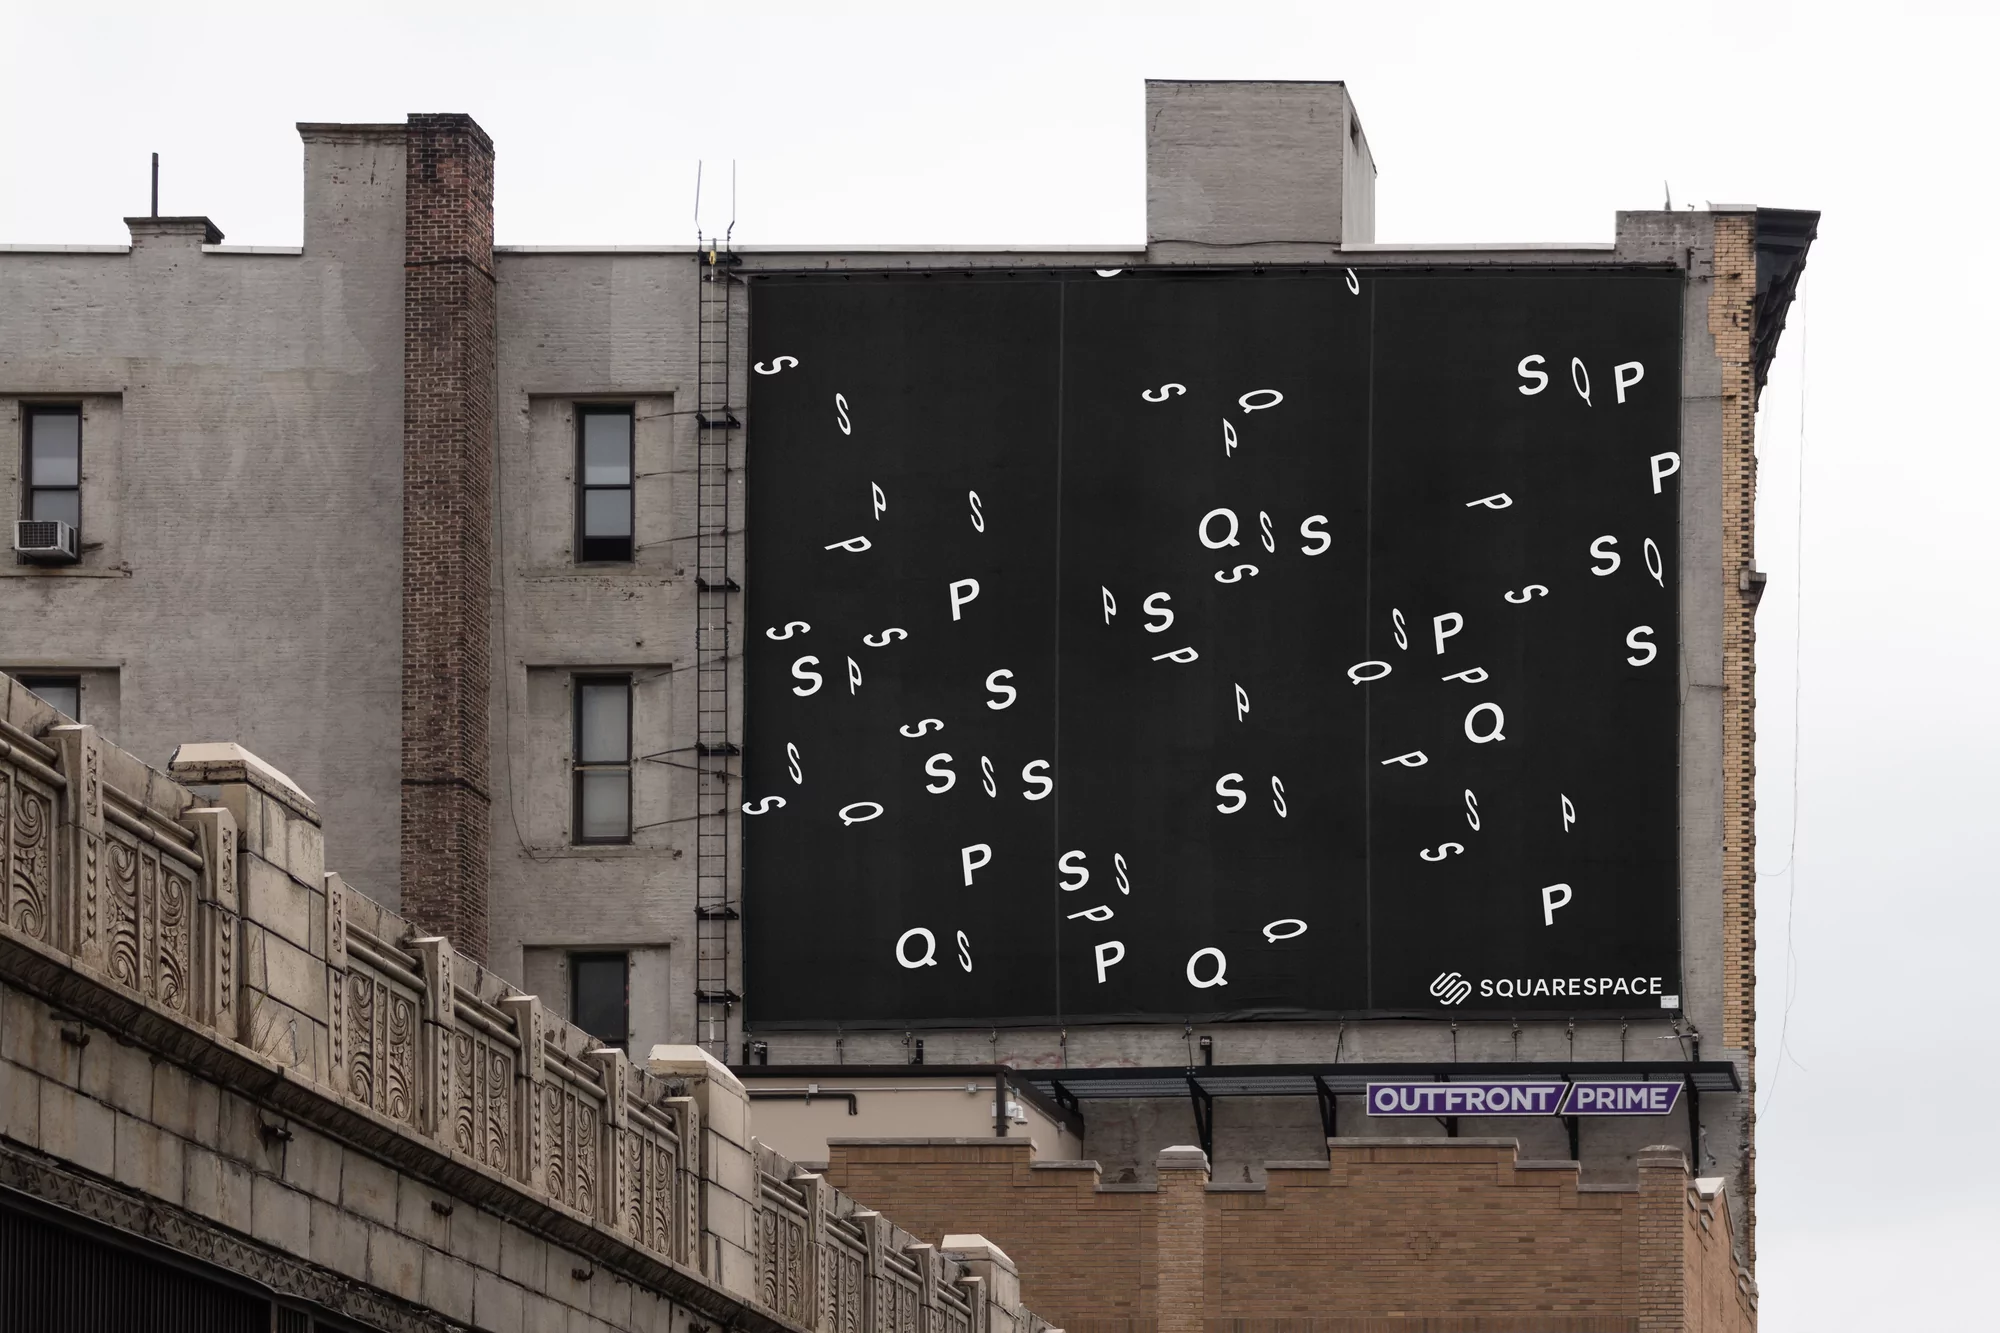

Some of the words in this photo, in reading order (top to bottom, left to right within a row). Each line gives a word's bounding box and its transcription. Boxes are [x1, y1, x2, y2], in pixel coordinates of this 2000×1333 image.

[754, 356, 798, 374] S
[1518, 355, 1548, 395] S
[1572, 357, 1591, 406] Q
[1615, 362, 1644, 403] P
[1142, 384, 1186, 402] S
[1239, 390, 1283, 413] Q
[836, 393, 851, 435] S
[1223, 418, 1237, 457] P
[1651, 452, 1680, 494] P
[872, 482, 886, 520] P
[969, 491, 984, 532] S
[1466, 493, 1512, 509] P
[825, 536, 871, 552] P
[1199, 508, 1240, 549] Q
[1260, 511, 1274, 553] S
[1301, 515, 1331, 555] S
[1215, 565, 1259, 583] S
[1590, 536, 1620, 576] S
[1644, 538, 1664, 587] Q
[950, 579, 979, 621] P
[1102, 586, 1116, 624] P
[1143, 592, 1174, 632] S
[1505, 585, 1548, 603] S
[766, 622, 810, 640] S
[863, 628, 907, 646] S
[1393, 608, 1407, 650] S
[1434, 613, 1463, 654] P
[1627, 626, 1656, 666] S
[1152, 647, 1198, 663] P
[1348, 661, 1392, 685] Q
[792, 656, 822, 696] S
[848, 656, 861, 695] P
[986, 669, 1016, 710] S
[1442, 667, 1488, 683] P
[1235, 683, 1249, 722] P
[900, 719, 944, 737] S
[1465, 703, 1505, 743] Q
[787, 743, 802, 784] S
[925, 753, 956, 794] S
[981, 756, 996, 797] S
[1022, 760, 1053, 800] S
[1382, 751, 1428, 767] P
[742, 796, 786, 814] S
[839, 802, 883, 826] Q
[1216, 773, 1246, 813] S
[1272, 776, 1286, 817] S
[1465, 789, 1480, 831] S
[1561, 794, 1575, 832] P
[962, 844, 991, 886] P
[1420, 843, 1464, 861] S
[1059, 850, 1089, 891] S
[1115, 853, 1129, 895] S
[1067, 905, 1114, 921] P
[1542, 884, 1571, 926] P
[896, 928, 937, 968] Q
[957, 930, 972, 972] S
[1263, 919, 1307, 943] Q
[1095, 941, 1124, 983] P
[1187, 948, 1227, 988] Q
[1480, 977, 1662, 997] SQUARESPACE
[1375, 1087, 1556, 1111] OUTFRONT
[1577, 1087, 1669, 1109] PRIME
